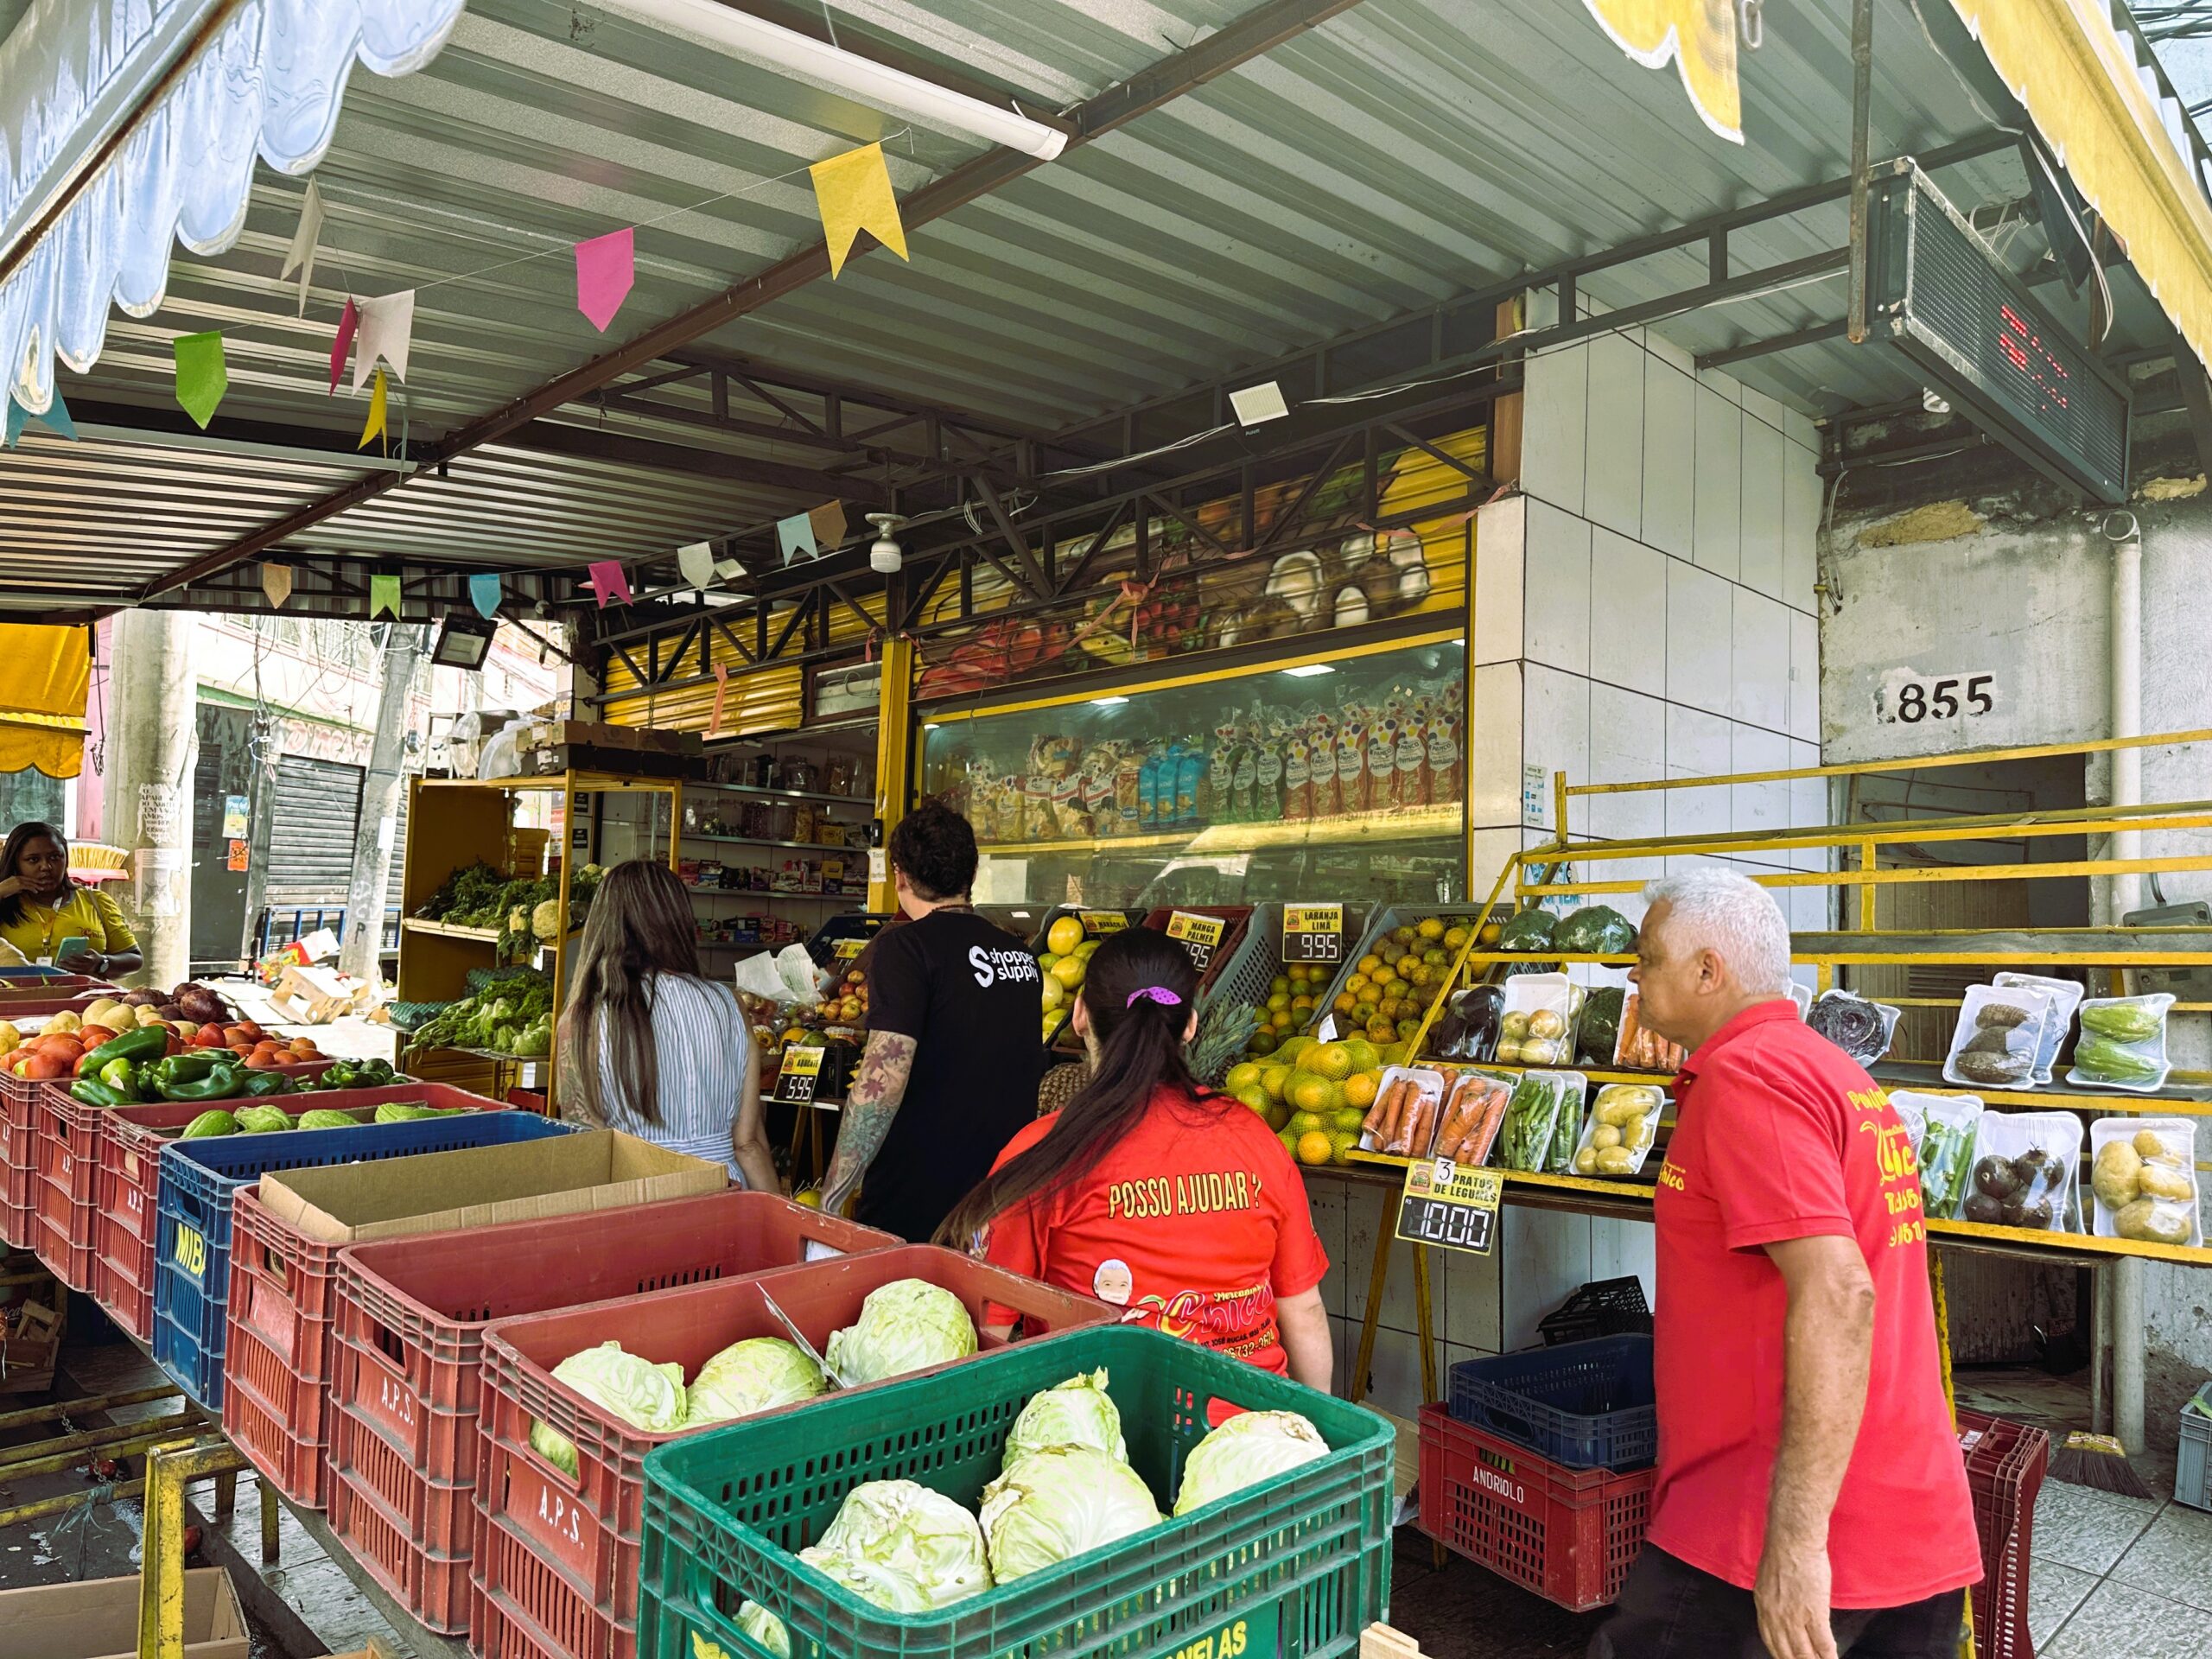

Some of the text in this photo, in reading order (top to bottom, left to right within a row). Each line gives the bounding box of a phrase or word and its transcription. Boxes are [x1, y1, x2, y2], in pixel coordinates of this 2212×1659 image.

[1305, 912, 1338, 920] LARANJA
[1192, 922, 1216, 934] MANGA
[1312, 922, 1331, 931] LIMA
[1186, 931, 1214, 944] PALMER
[989, 948, 1035, 965] shopper
[997, 964, 1039, 982] supply
[1439, 1161, 1494, 1191] 3 PRATOS
[1108, 1176, 1172, 1218] POSSO
[1434, 1184, 1497, 1203] DE LEGUMES
[381, 1376, 415, 1426] A.P.S.
[1472, 1465, 1524, 1503] ANDRIOLO
[539, 1485, 585, 1550] A.P.S.
